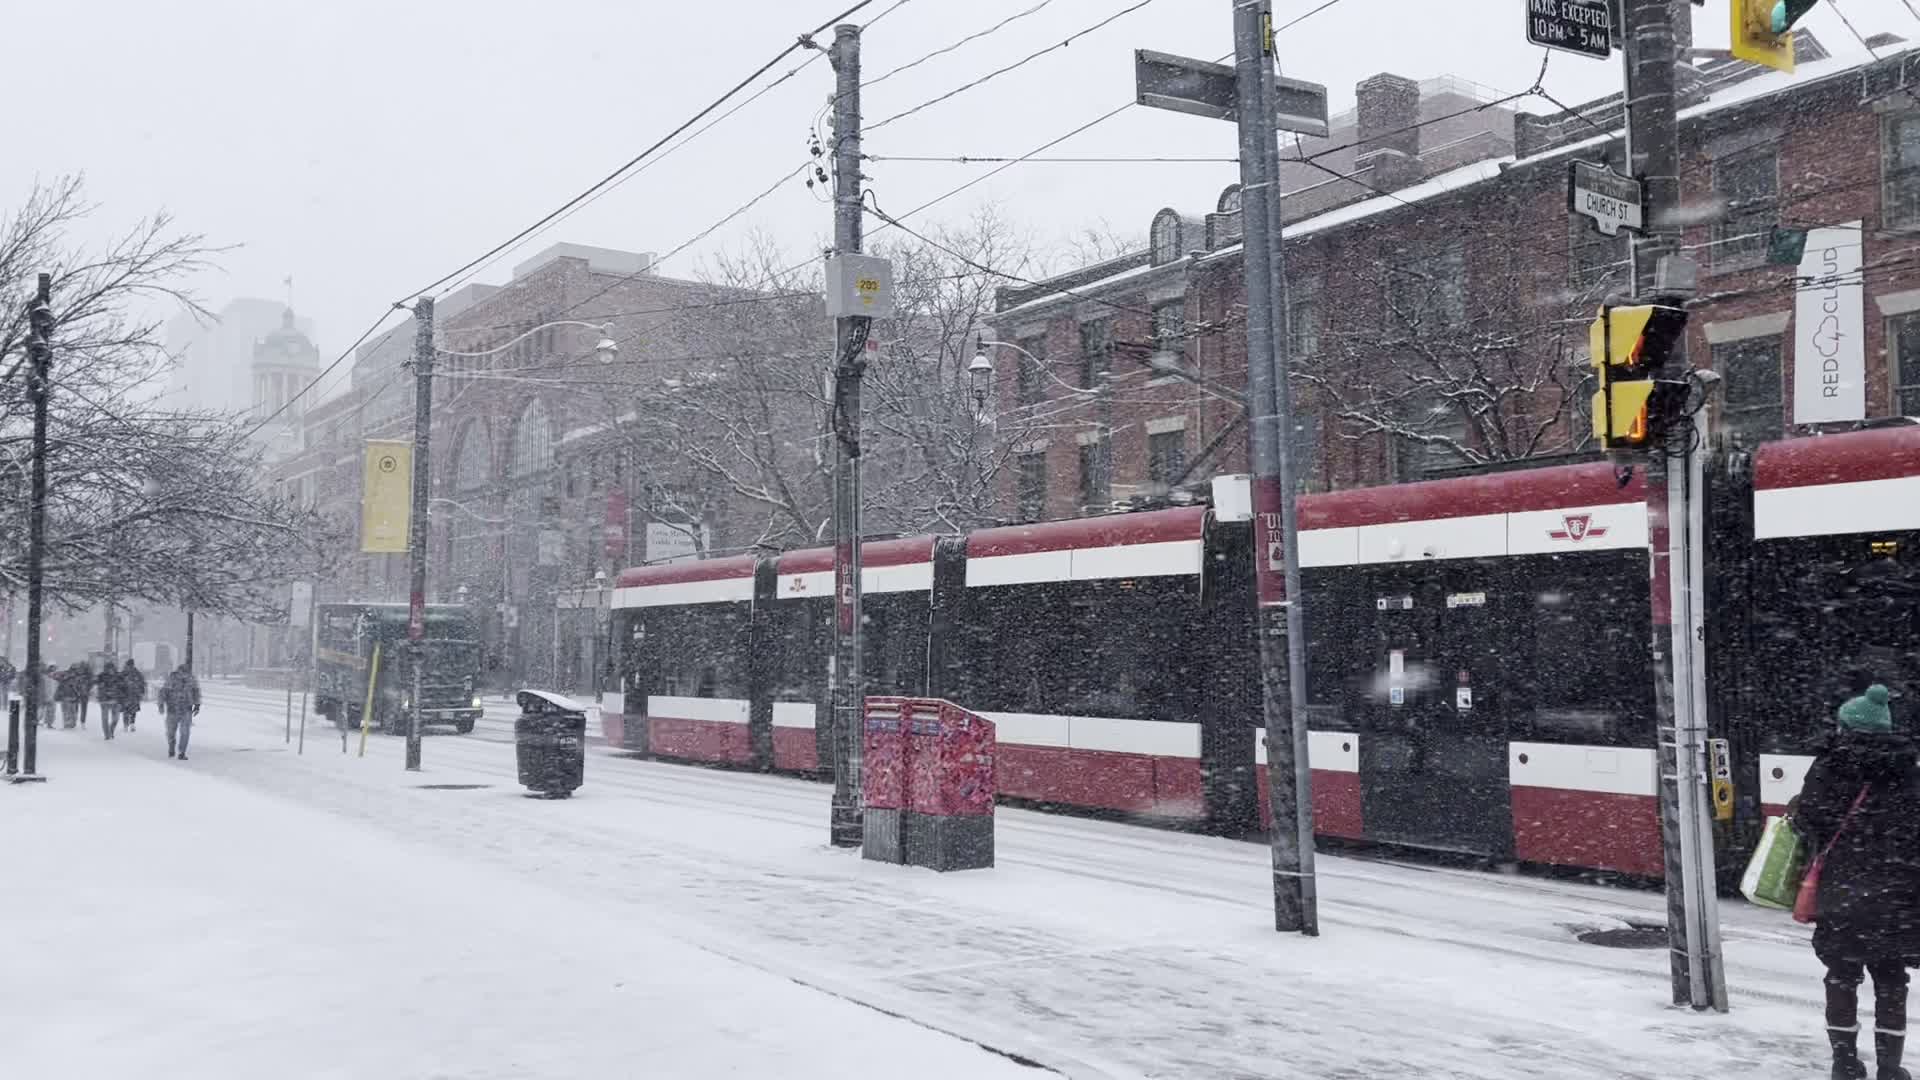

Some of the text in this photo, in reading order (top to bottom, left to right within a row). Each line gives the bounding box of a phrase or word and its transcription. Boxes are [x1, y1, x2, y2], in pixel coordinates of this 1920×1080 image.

[1561, 1, 1608, 28] EXCEPTED
[1534, 17, 1547, 37] 10
[1580, 28, 1588, 46] 5
[1586, 193, 1628, 220] CHURCH ST
[1823, 247, 1839, 398] RED CLOUD
